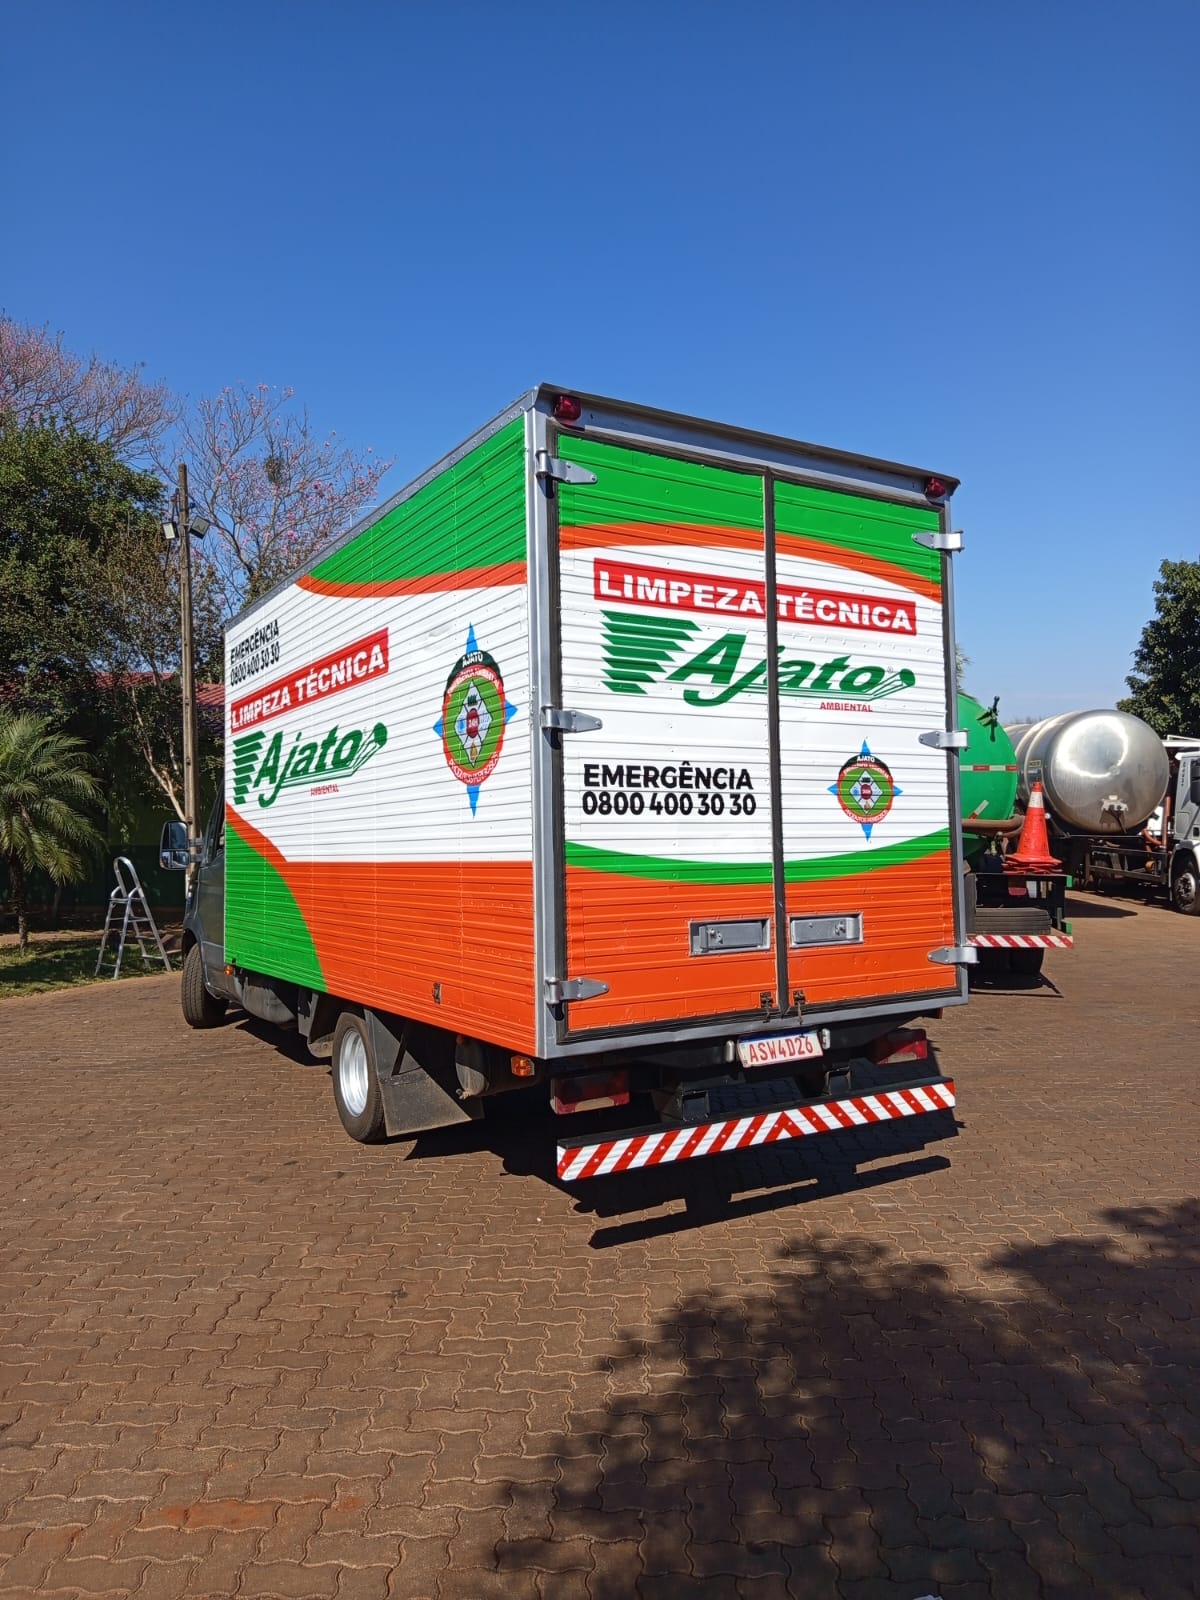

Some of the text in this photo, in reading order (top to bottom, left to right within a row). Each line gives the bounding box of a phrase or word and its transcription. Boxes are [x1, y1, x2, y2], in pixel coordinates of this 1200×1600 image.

[598, 571, 914, 631] LIMPEZA TÉCNICA
[230, 619, 279, 664] EMERGÊNCIA
[230, 661, 247, 686] 0800
[260, 648, 270, 670] 30
[270, 641, 280, 665] 30
[231, 645, 385, 728] LIMPEZA TÉCNICA
[665, 633, 886, 707] Ajato
[820, 702, 873, 713] AMBIENTAL
[253, 725, 363, 808] Ajato
[583, 760, 754, 790] EMERGÊNCIA
[582, 790, 757, 816] 0800 400 30 30
[748, 1036, 814, 1063] ASW4D26
